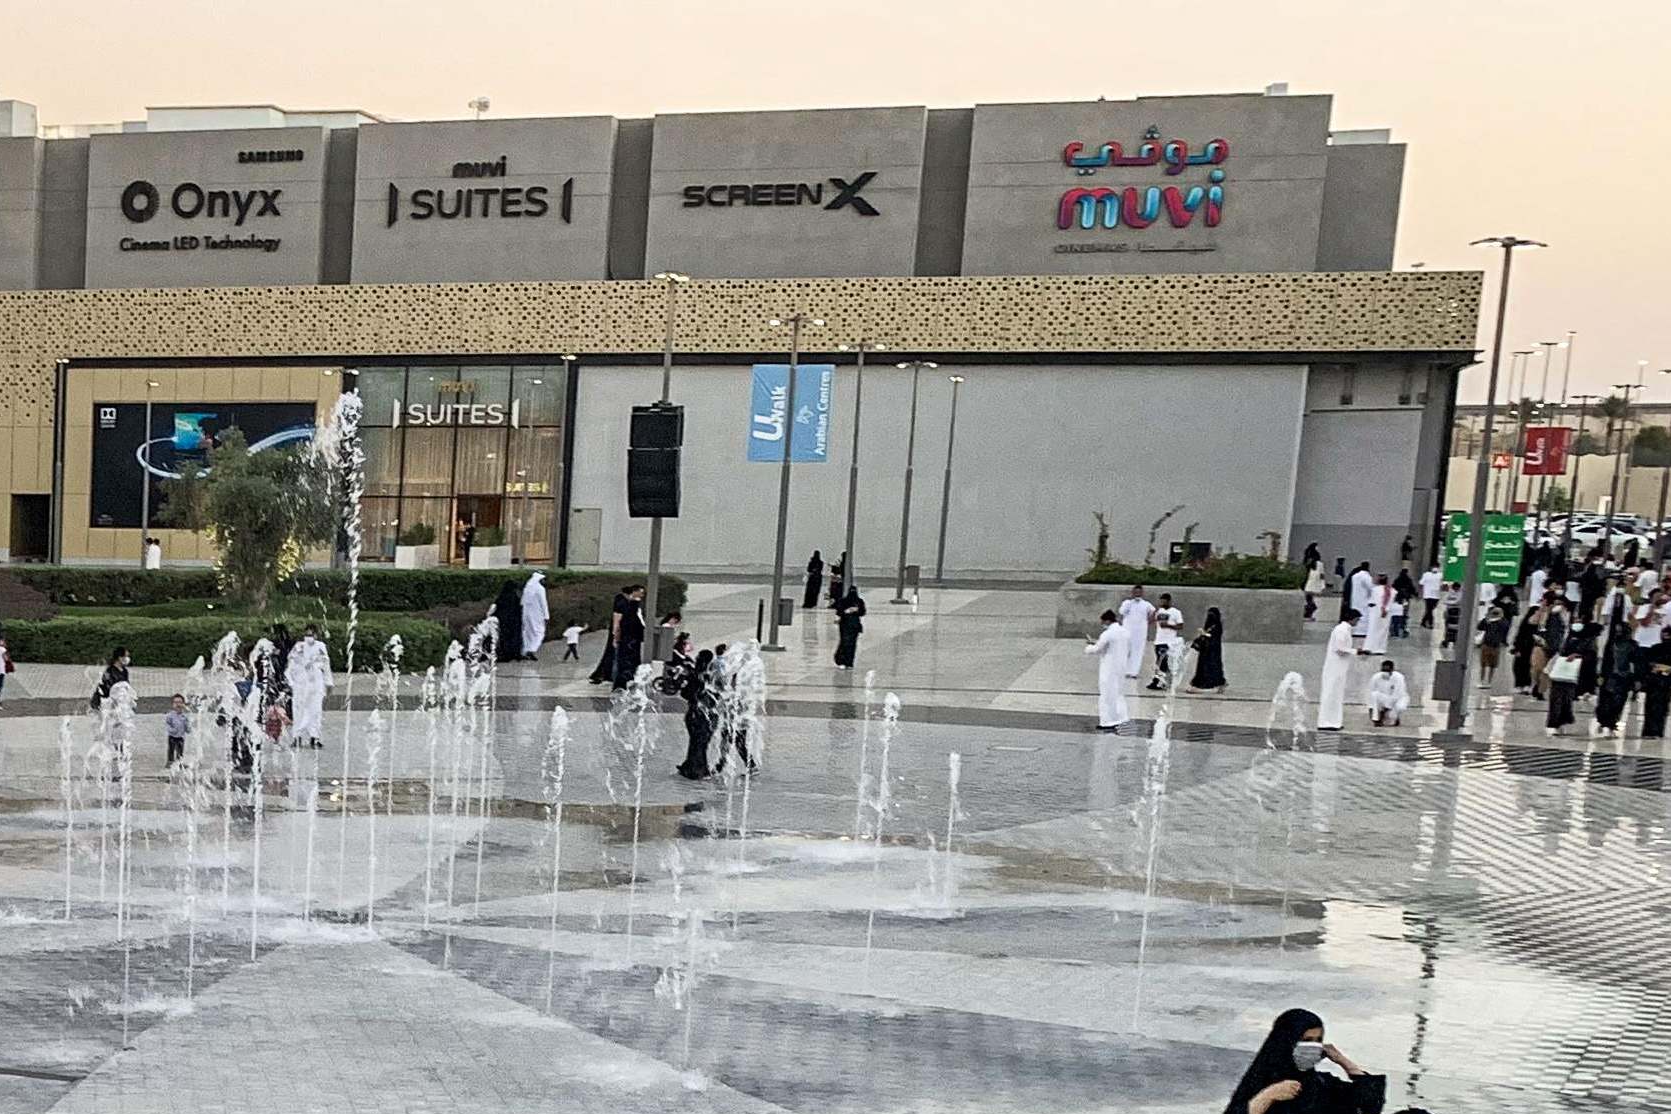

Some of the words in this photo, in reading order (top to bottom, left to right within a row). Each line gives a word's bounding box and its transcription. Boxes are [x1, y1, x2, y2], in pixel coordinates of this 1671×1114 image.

[238, 150, 304, 163] SAMSUNG
[452, 155, 507, 178] muvi
[171, 182, 282, 226] Onyx
[410, 186, 549, 220] SUITES
[1057, 168, 1226, 230] muvi
[120, 237, 170, 251] Cinema
[174, 236, 199, 250] LED
[204, 234, 281, 252] Technology
[817, 371, 831, 411] Centres
[408, 403, 504, 424] SUITES
[814, 413, 828, 456] Arabian
